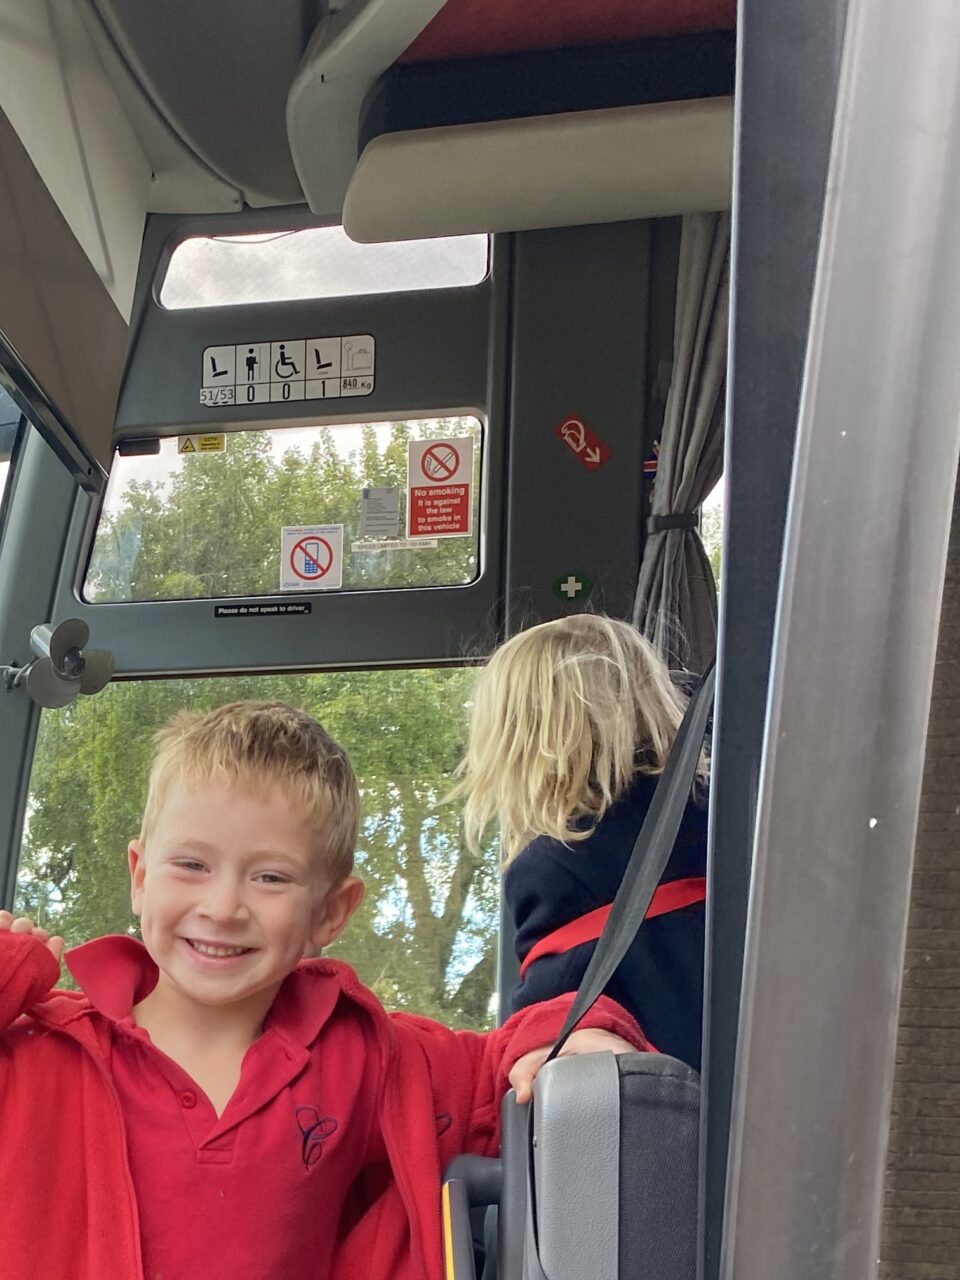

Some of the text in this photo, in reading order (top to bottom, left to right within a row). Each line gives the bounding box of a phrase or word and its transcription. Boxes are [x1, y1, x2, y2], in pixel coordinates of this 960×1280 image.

[320, 381, 326, 397] 1
[342, 378, 358, 389] 840
[200, 388, 234, 401] 51/53
[247, 385, 255, 402] 0
[282, 383, 290, 400] 0
[415, 487, 465, 497] No smoking
[433, 498, 460, 506] against
